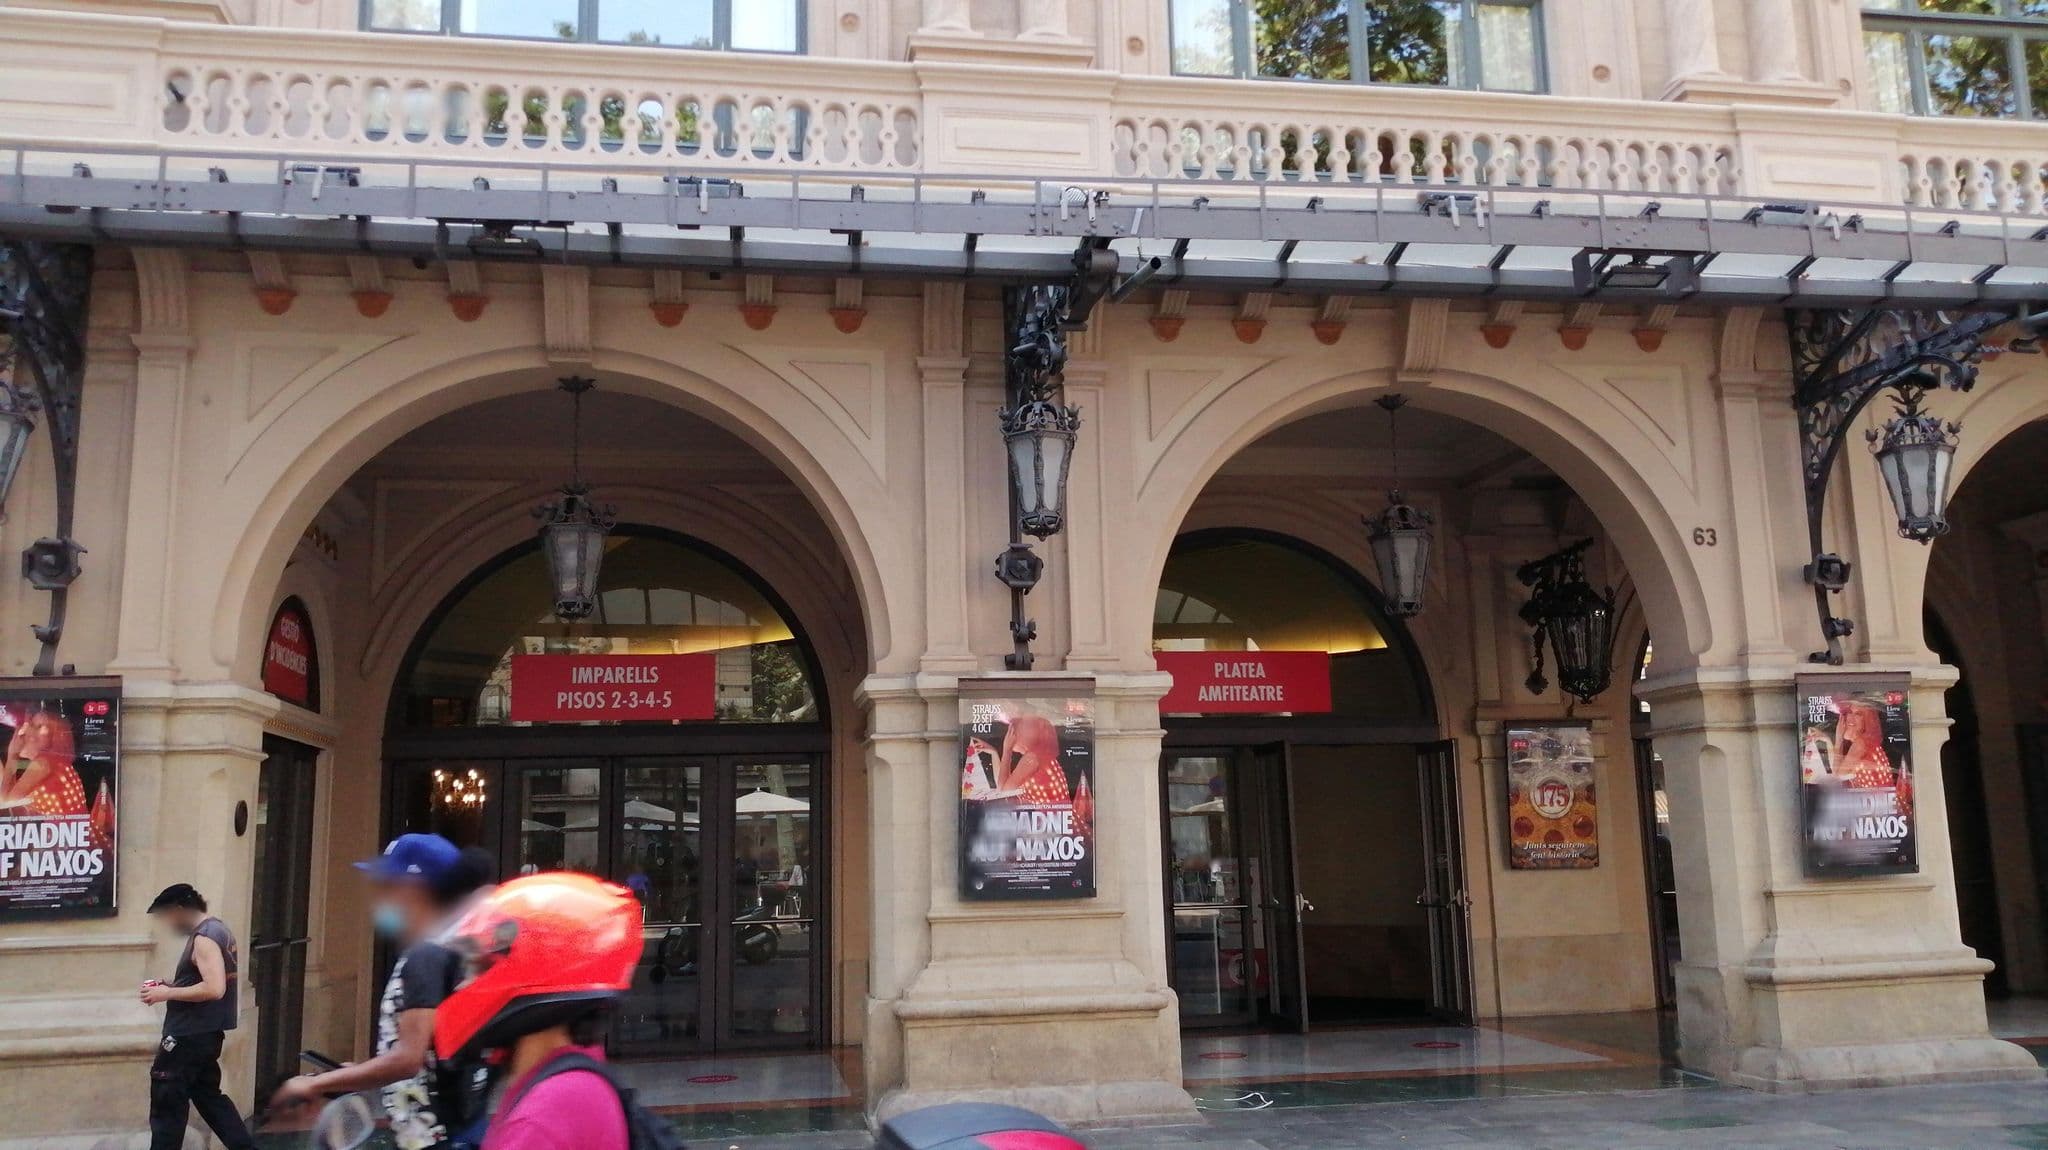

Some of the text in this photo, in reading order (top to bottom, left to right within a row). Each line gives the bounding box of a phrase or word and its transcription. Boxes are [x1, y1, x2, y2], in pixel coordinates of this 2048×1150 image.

[1693, 527, 1717, 547] 63
[572, 666, 659, 684] IMPARELLS
[1214, 662, 1266, 678] PLATEA
[557, 690, 672, 709] PISOS 2-3-4-5
[1198, 685, 1284, 702] AMFITEATRE
[1808, 696, 1833, 705] STRAUSS
[972, 704, 1001, 714] STRAUSS
[1809, 705, 1826, 714] 22 SET
[972, 713, 993, 723] 22 SET
[1809, 713, 1826, 723] 4 OCT
[972, 723, 992, 733] 4 OCT
[1537, 783, 1569, 808] 175
[1851, 815, 1908, 839] NAXOS
[1016, 836, 1085, 861] NAXOS
[1524, 841, 1547, 850] Junts
[20, 849, 104, 878] NAXOS
